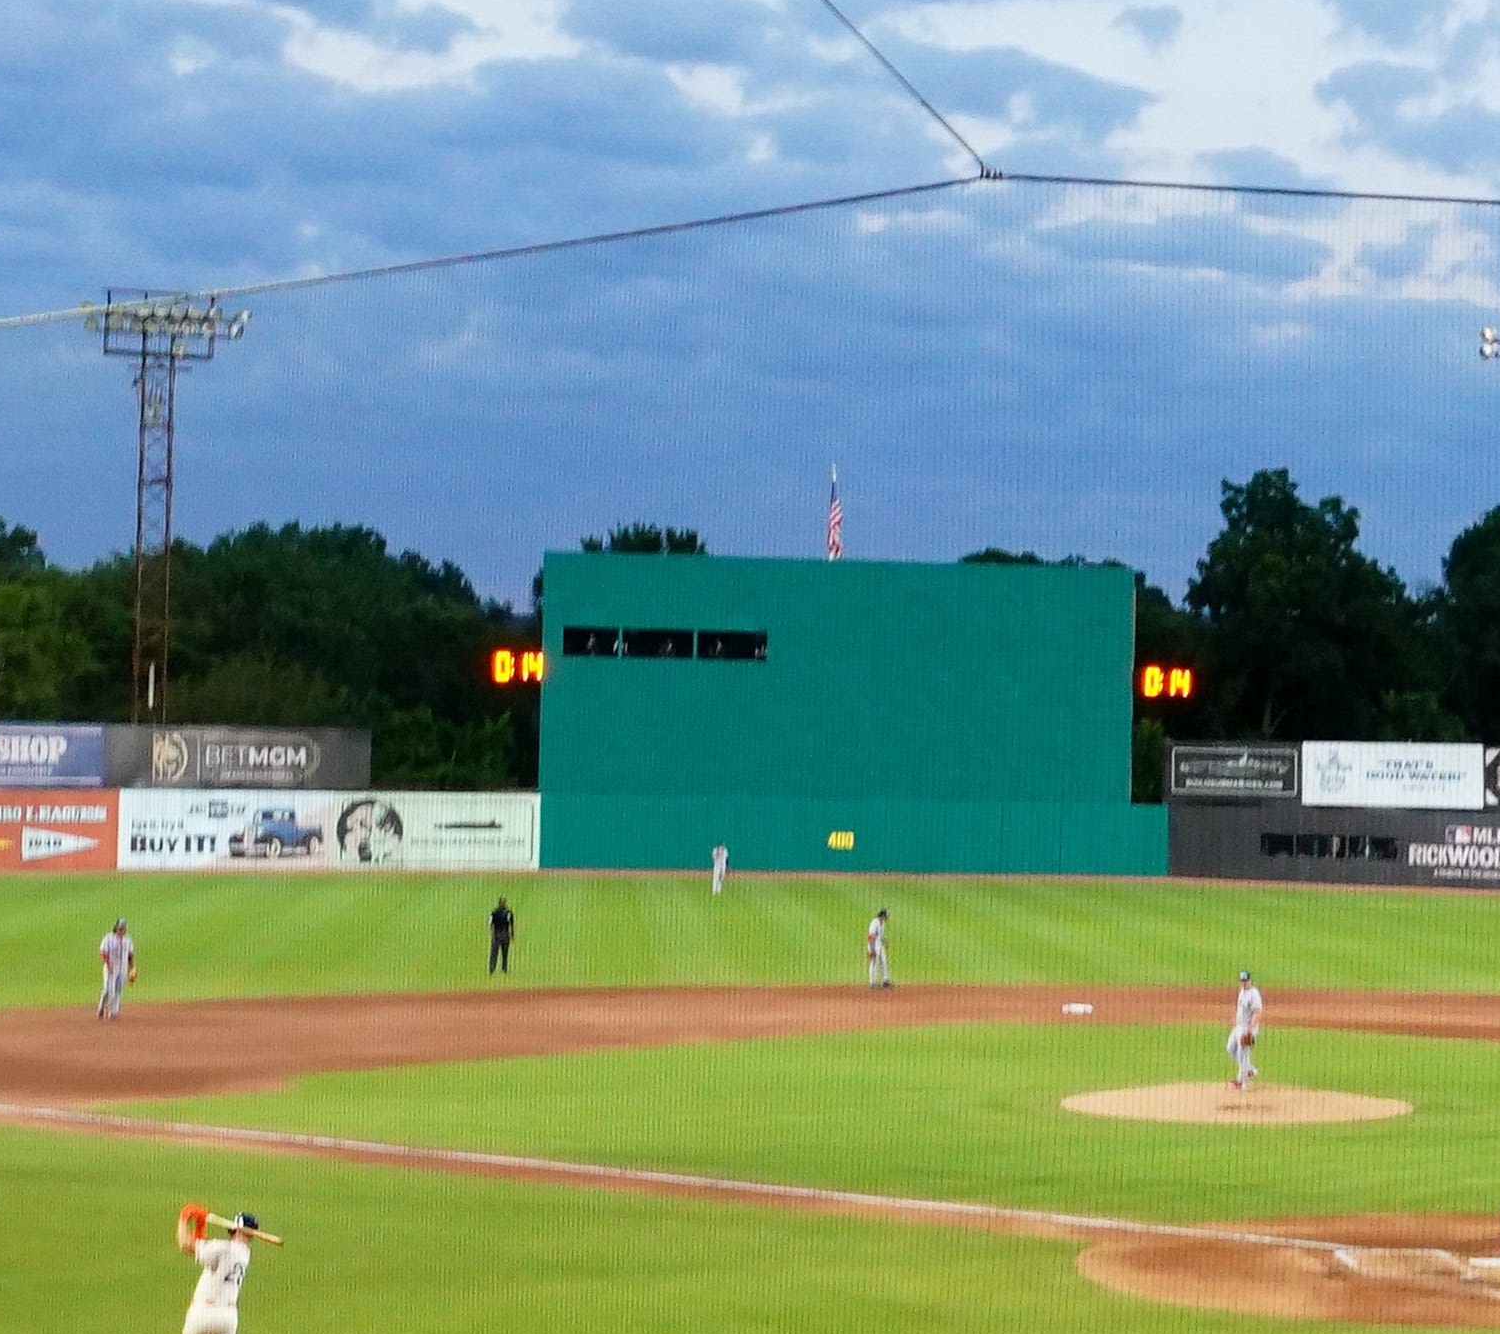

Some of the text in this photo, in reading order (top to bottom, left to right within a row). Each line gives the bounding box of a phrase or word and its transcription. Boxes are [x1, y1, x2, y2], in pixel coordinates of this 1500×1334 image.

[494, 650, 544, 683] 0:14
[1144, 666, 1191, 698] 0:14
[130, 834, 217, 854] BUY IT!
